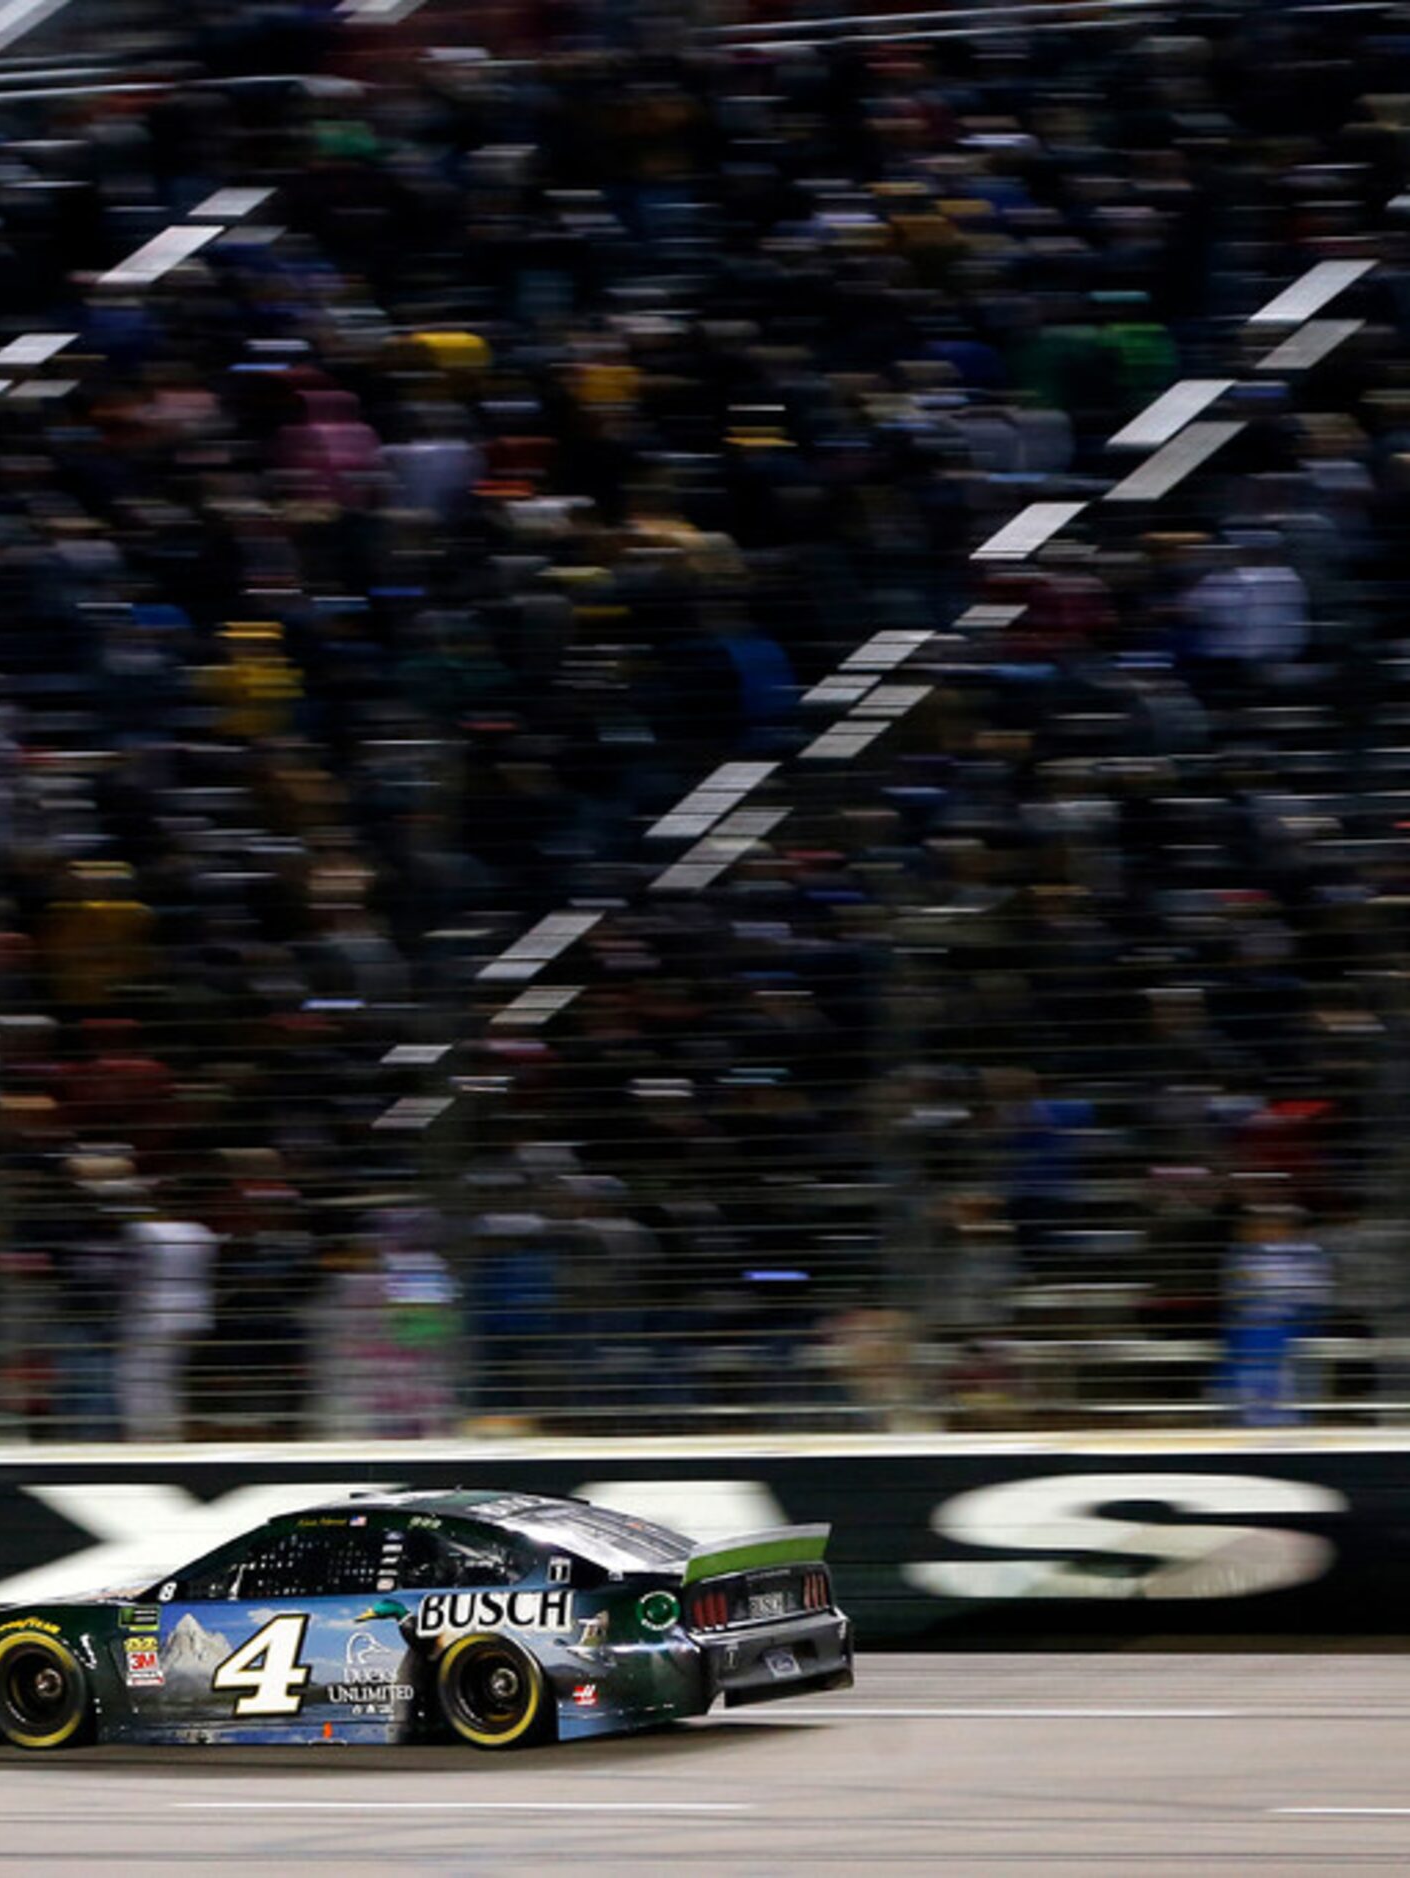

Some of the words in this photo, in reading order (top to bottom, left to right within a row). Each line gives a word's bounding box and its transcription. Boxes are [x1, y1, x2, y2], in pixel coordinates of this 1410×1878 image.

[418, 1590, 571, 1635] BUSCH
[130, 1653, 157, 1670] 3M
[212, 1613, 311, 1717] 4
[344, 1667, 397, 1684] DUCKS
[328, 1685, 414, 1703] UNLIMITED
